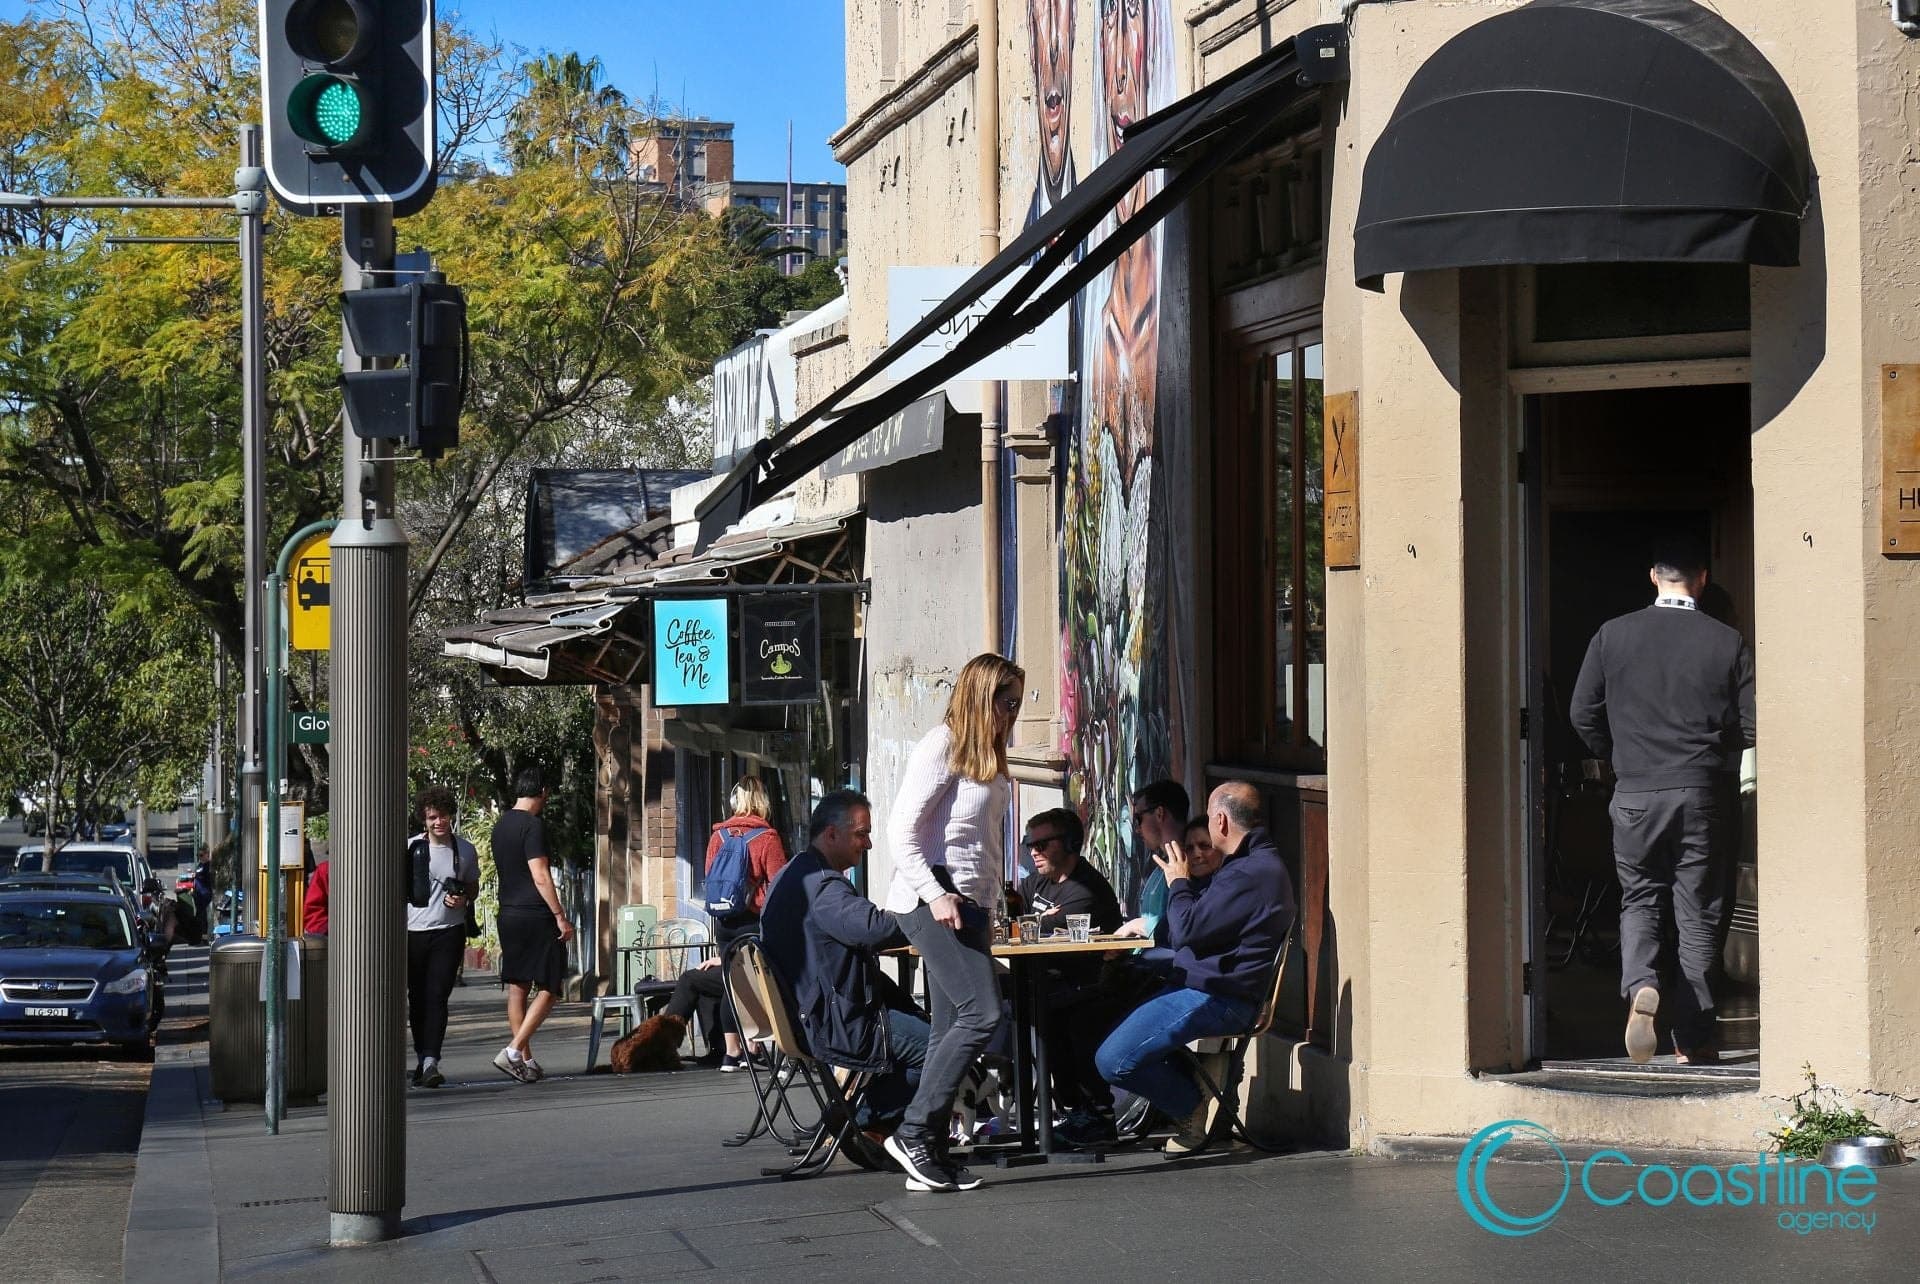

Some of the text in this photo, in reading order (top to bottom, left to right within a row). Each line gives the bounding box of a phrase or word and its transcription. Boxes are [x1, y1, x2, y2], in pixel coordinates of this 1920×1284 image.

[674, 645, 711, 669] Tea &
[682, 662, 711, 690] Me
